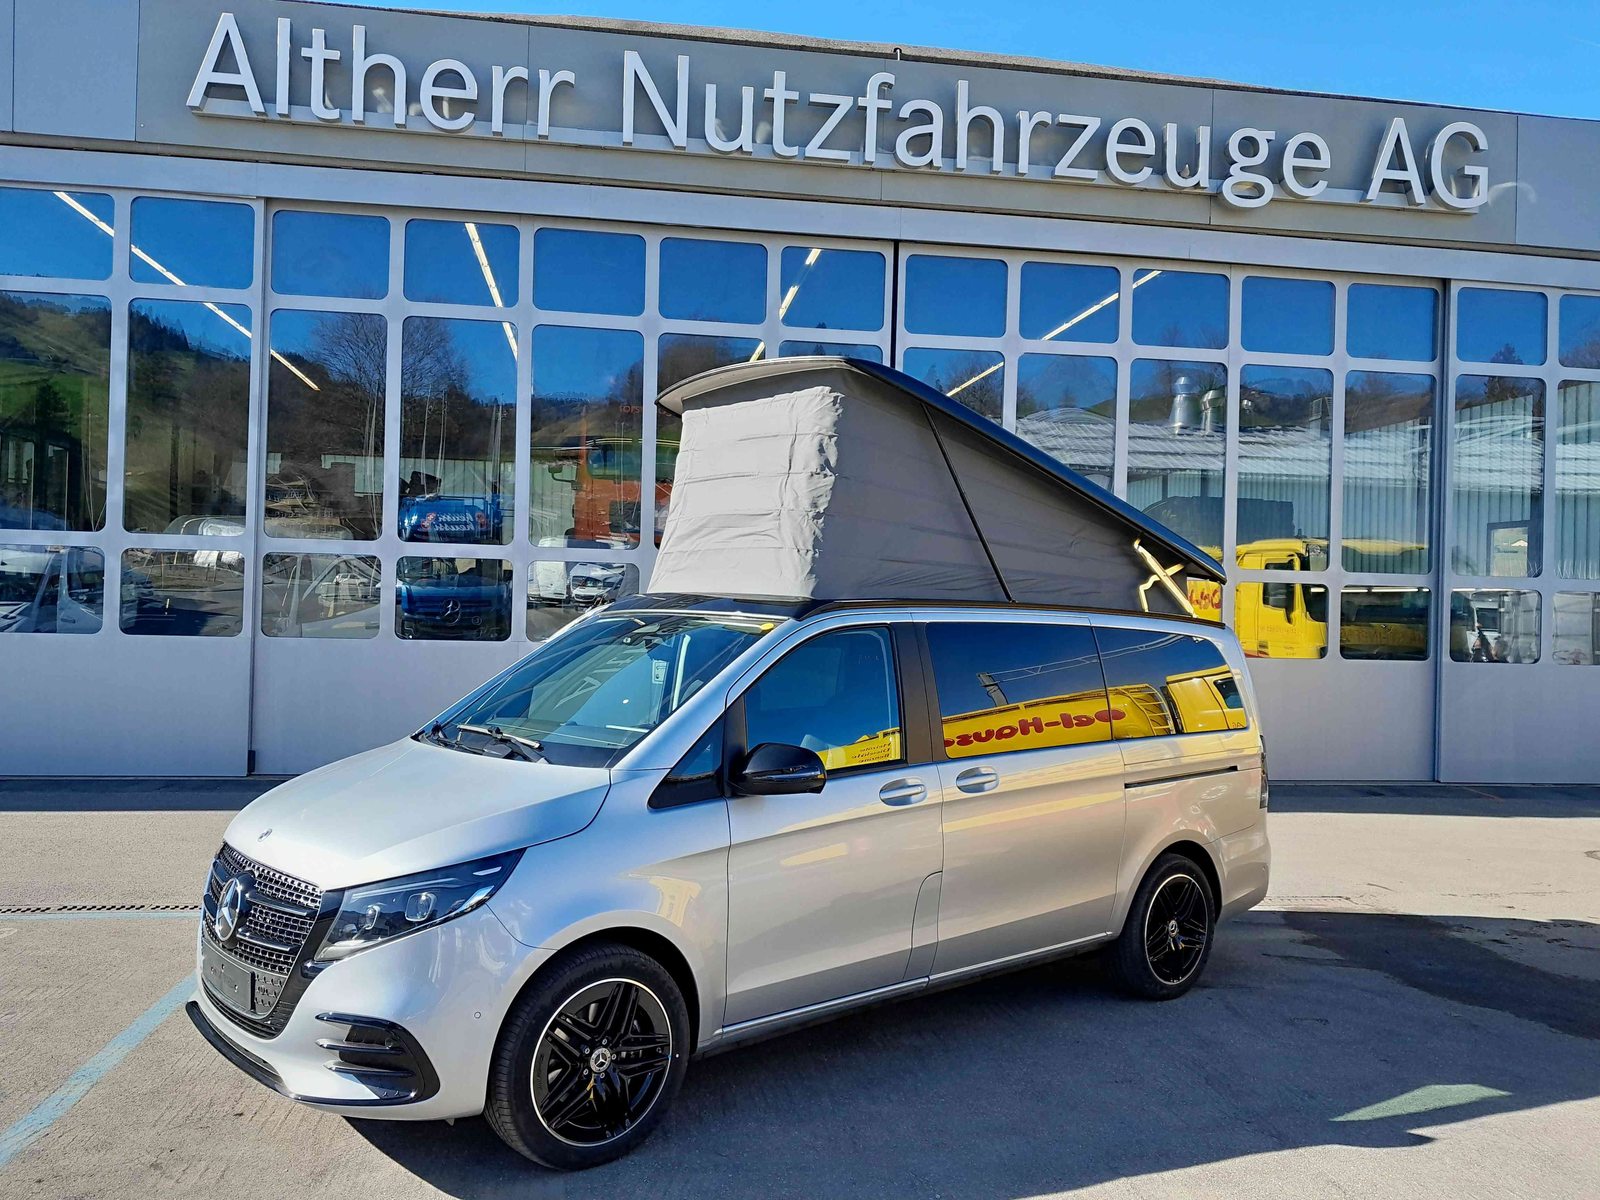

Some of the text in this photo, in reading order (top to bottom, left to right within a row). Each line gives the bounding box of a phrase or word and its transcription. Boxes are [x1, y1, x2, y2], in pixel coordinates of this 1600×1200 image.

[186, 12, 1490, 210] Altherr Nutzfahrzeuge AG
